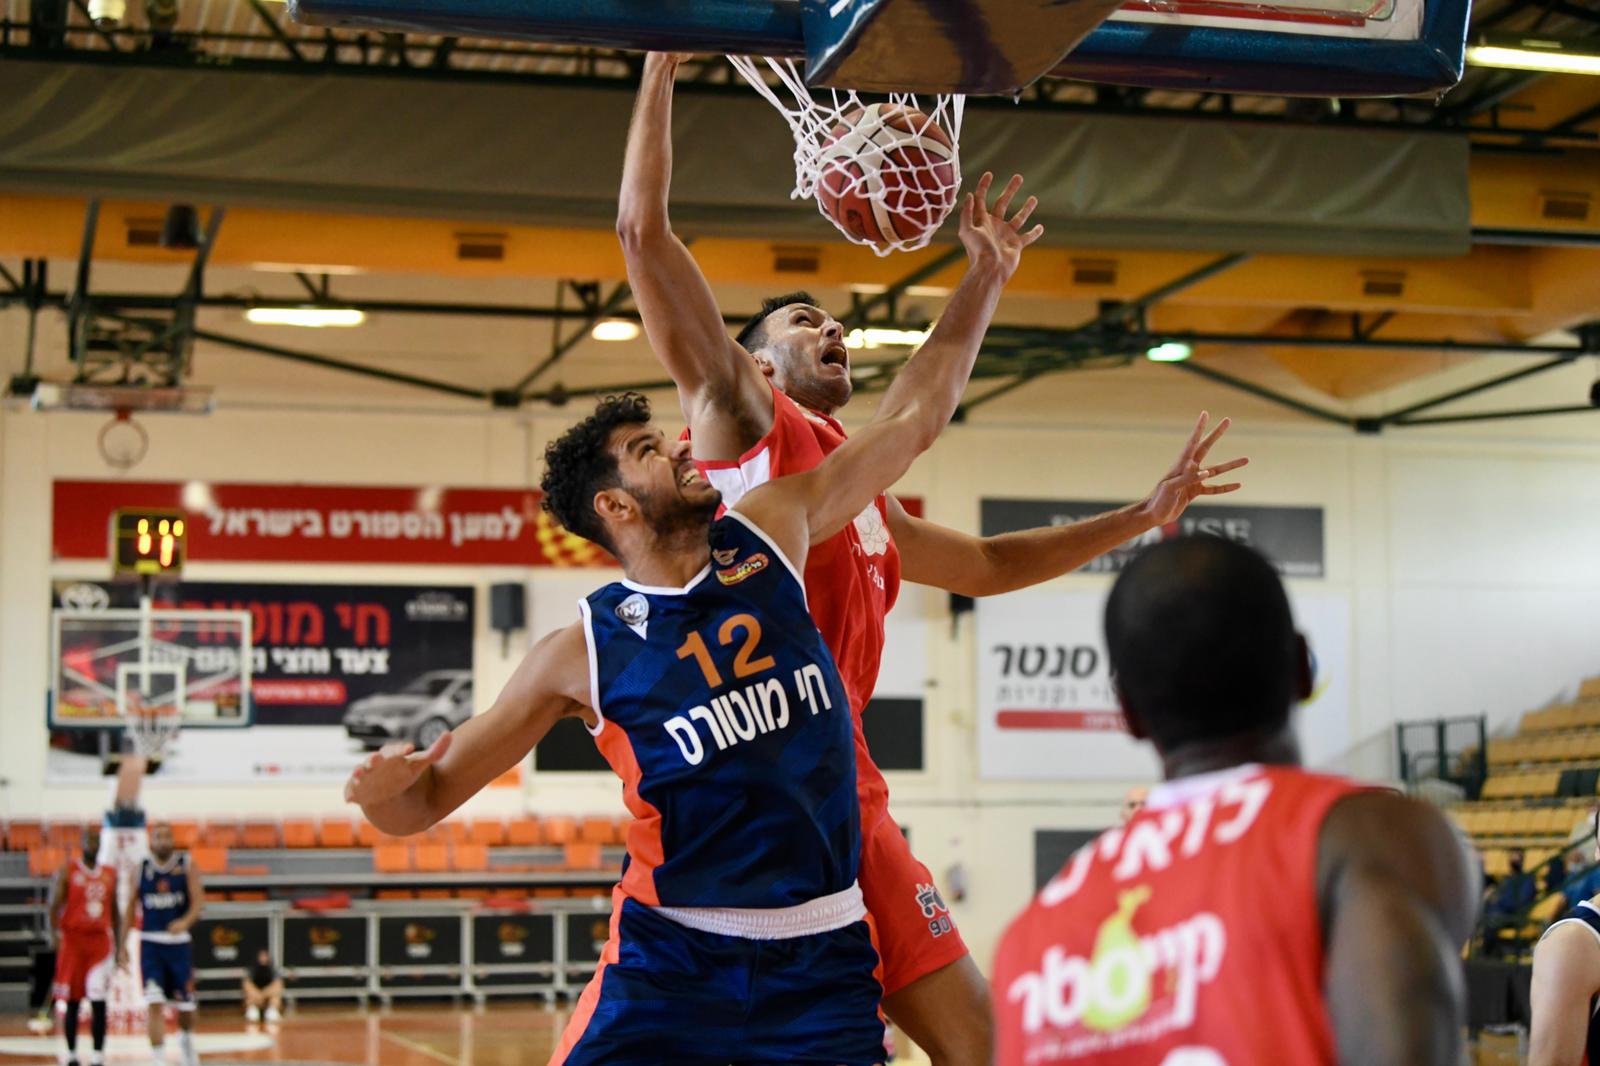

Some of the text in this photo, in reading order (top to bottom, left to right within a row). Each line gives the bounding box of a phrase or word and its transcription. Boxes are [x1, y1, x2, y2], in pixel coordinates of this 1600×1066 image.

[206, 505, 522, 547] למען הספורט בישראל
[335, 602, 391, 645] חי
[676, 613, 776, 688] 12
[993, 645, 1098, 678] סנטר
[663, 663, 832, 765] חי מוטורס
[928, 916, 951, 938] 90
